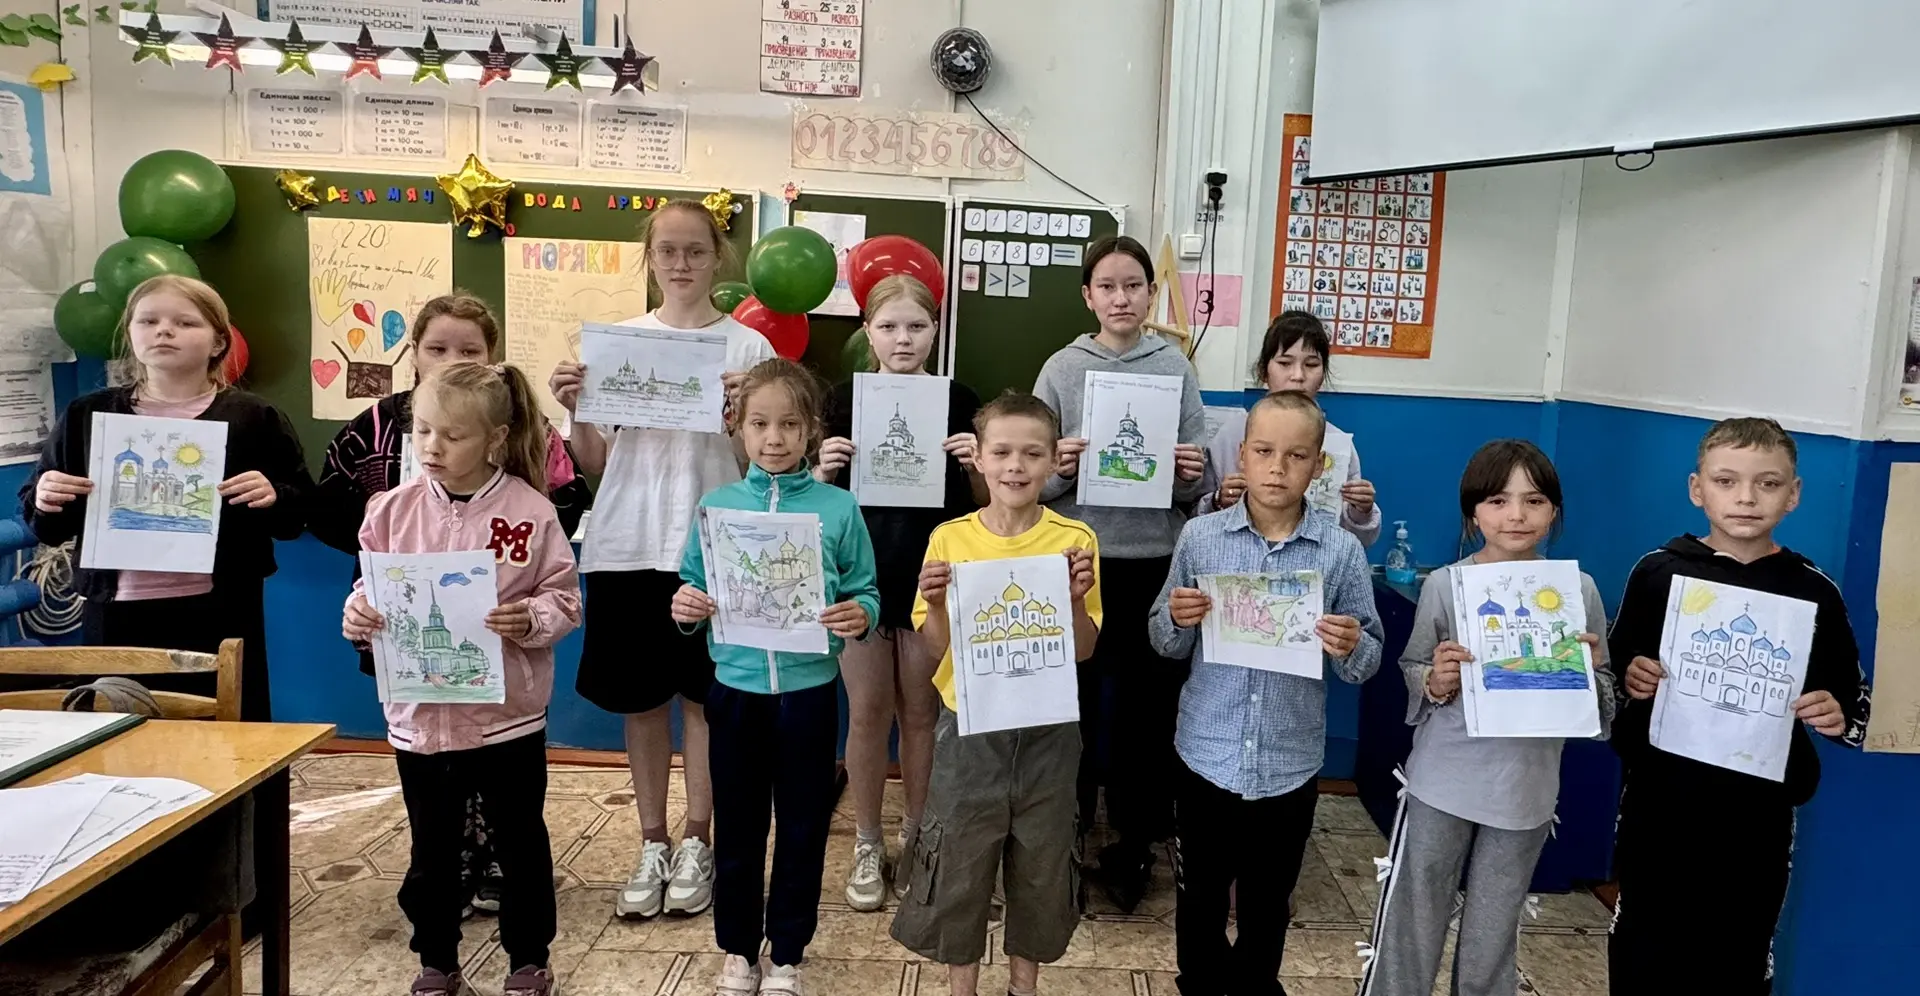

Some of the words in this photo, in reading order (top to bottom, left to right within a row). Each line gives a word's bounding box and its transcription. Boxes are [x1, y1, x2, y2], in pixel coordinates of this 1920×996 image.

[820, 2, 831, 12] 25
[846, 5, 856, 14] 23
[784, 10, 818, 22] РАЗНОСТЬ
[832, 14, 859, 25] РАЗНОСТЬ
[260, 92, 300, 100] Единицы
[784, 81, 818, 92] ЧАСТНОЕ
[832, 84, 859, 96] ЧАСТНОЕ
[365, 96, 402, 104] Единицы
[327, 185, 377, 205] ДЕТИ
[387, 186, 434, 205] МЯЧ
[524, 193, 582, 212] ВОДА
[970, 212, 981, 226] 0
[992, 213, 1000, 226] 1
[1012, 214, 1023, 228] 2
[1033, 216, 1044, 230] 3
[1054, 218, 1064, 231] 4
[1076, 218, 1088, 232] 5
[522, 242, 621, 276] МОРЯКИ
[969, 243, 979, 256] 6
[990, 244, 1000, 258] 7
[1012, 245, 1021, 259] 8
[1034, 246, 1044, 261] 9
